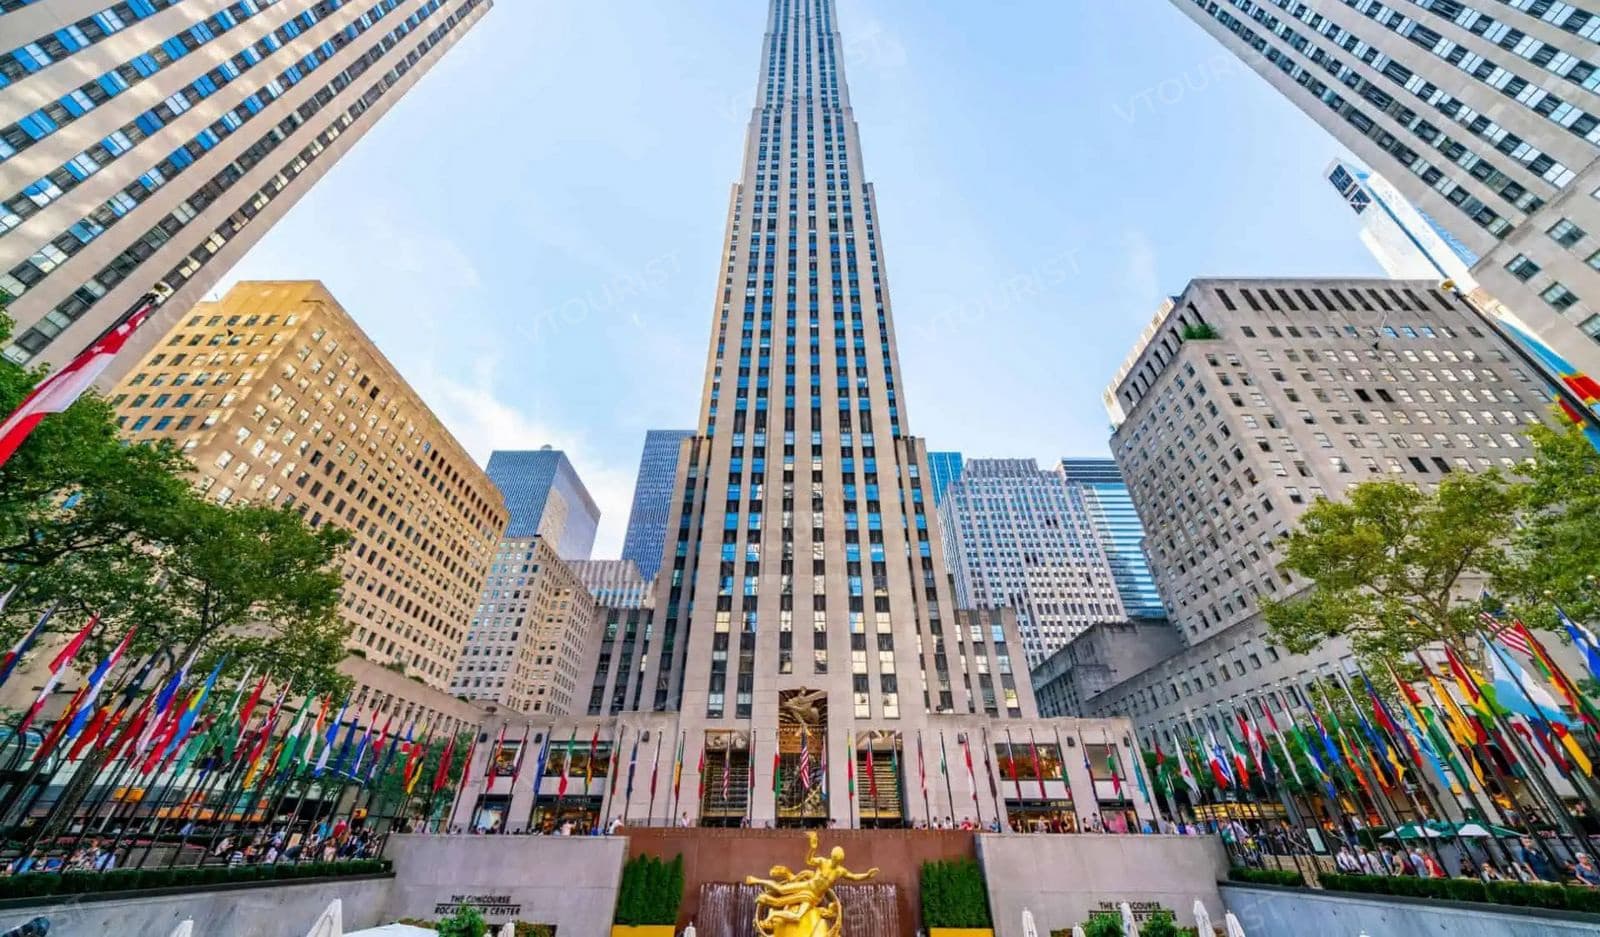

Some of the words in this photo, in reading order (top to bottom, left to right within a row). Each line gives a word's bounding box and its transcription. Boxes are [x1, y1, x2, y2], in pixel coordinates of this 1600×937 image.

[451, 895, 465, 903] THE
[467, 895, 512, 904] CONCOURSE
[490, 907, 521, 915] CENTER
